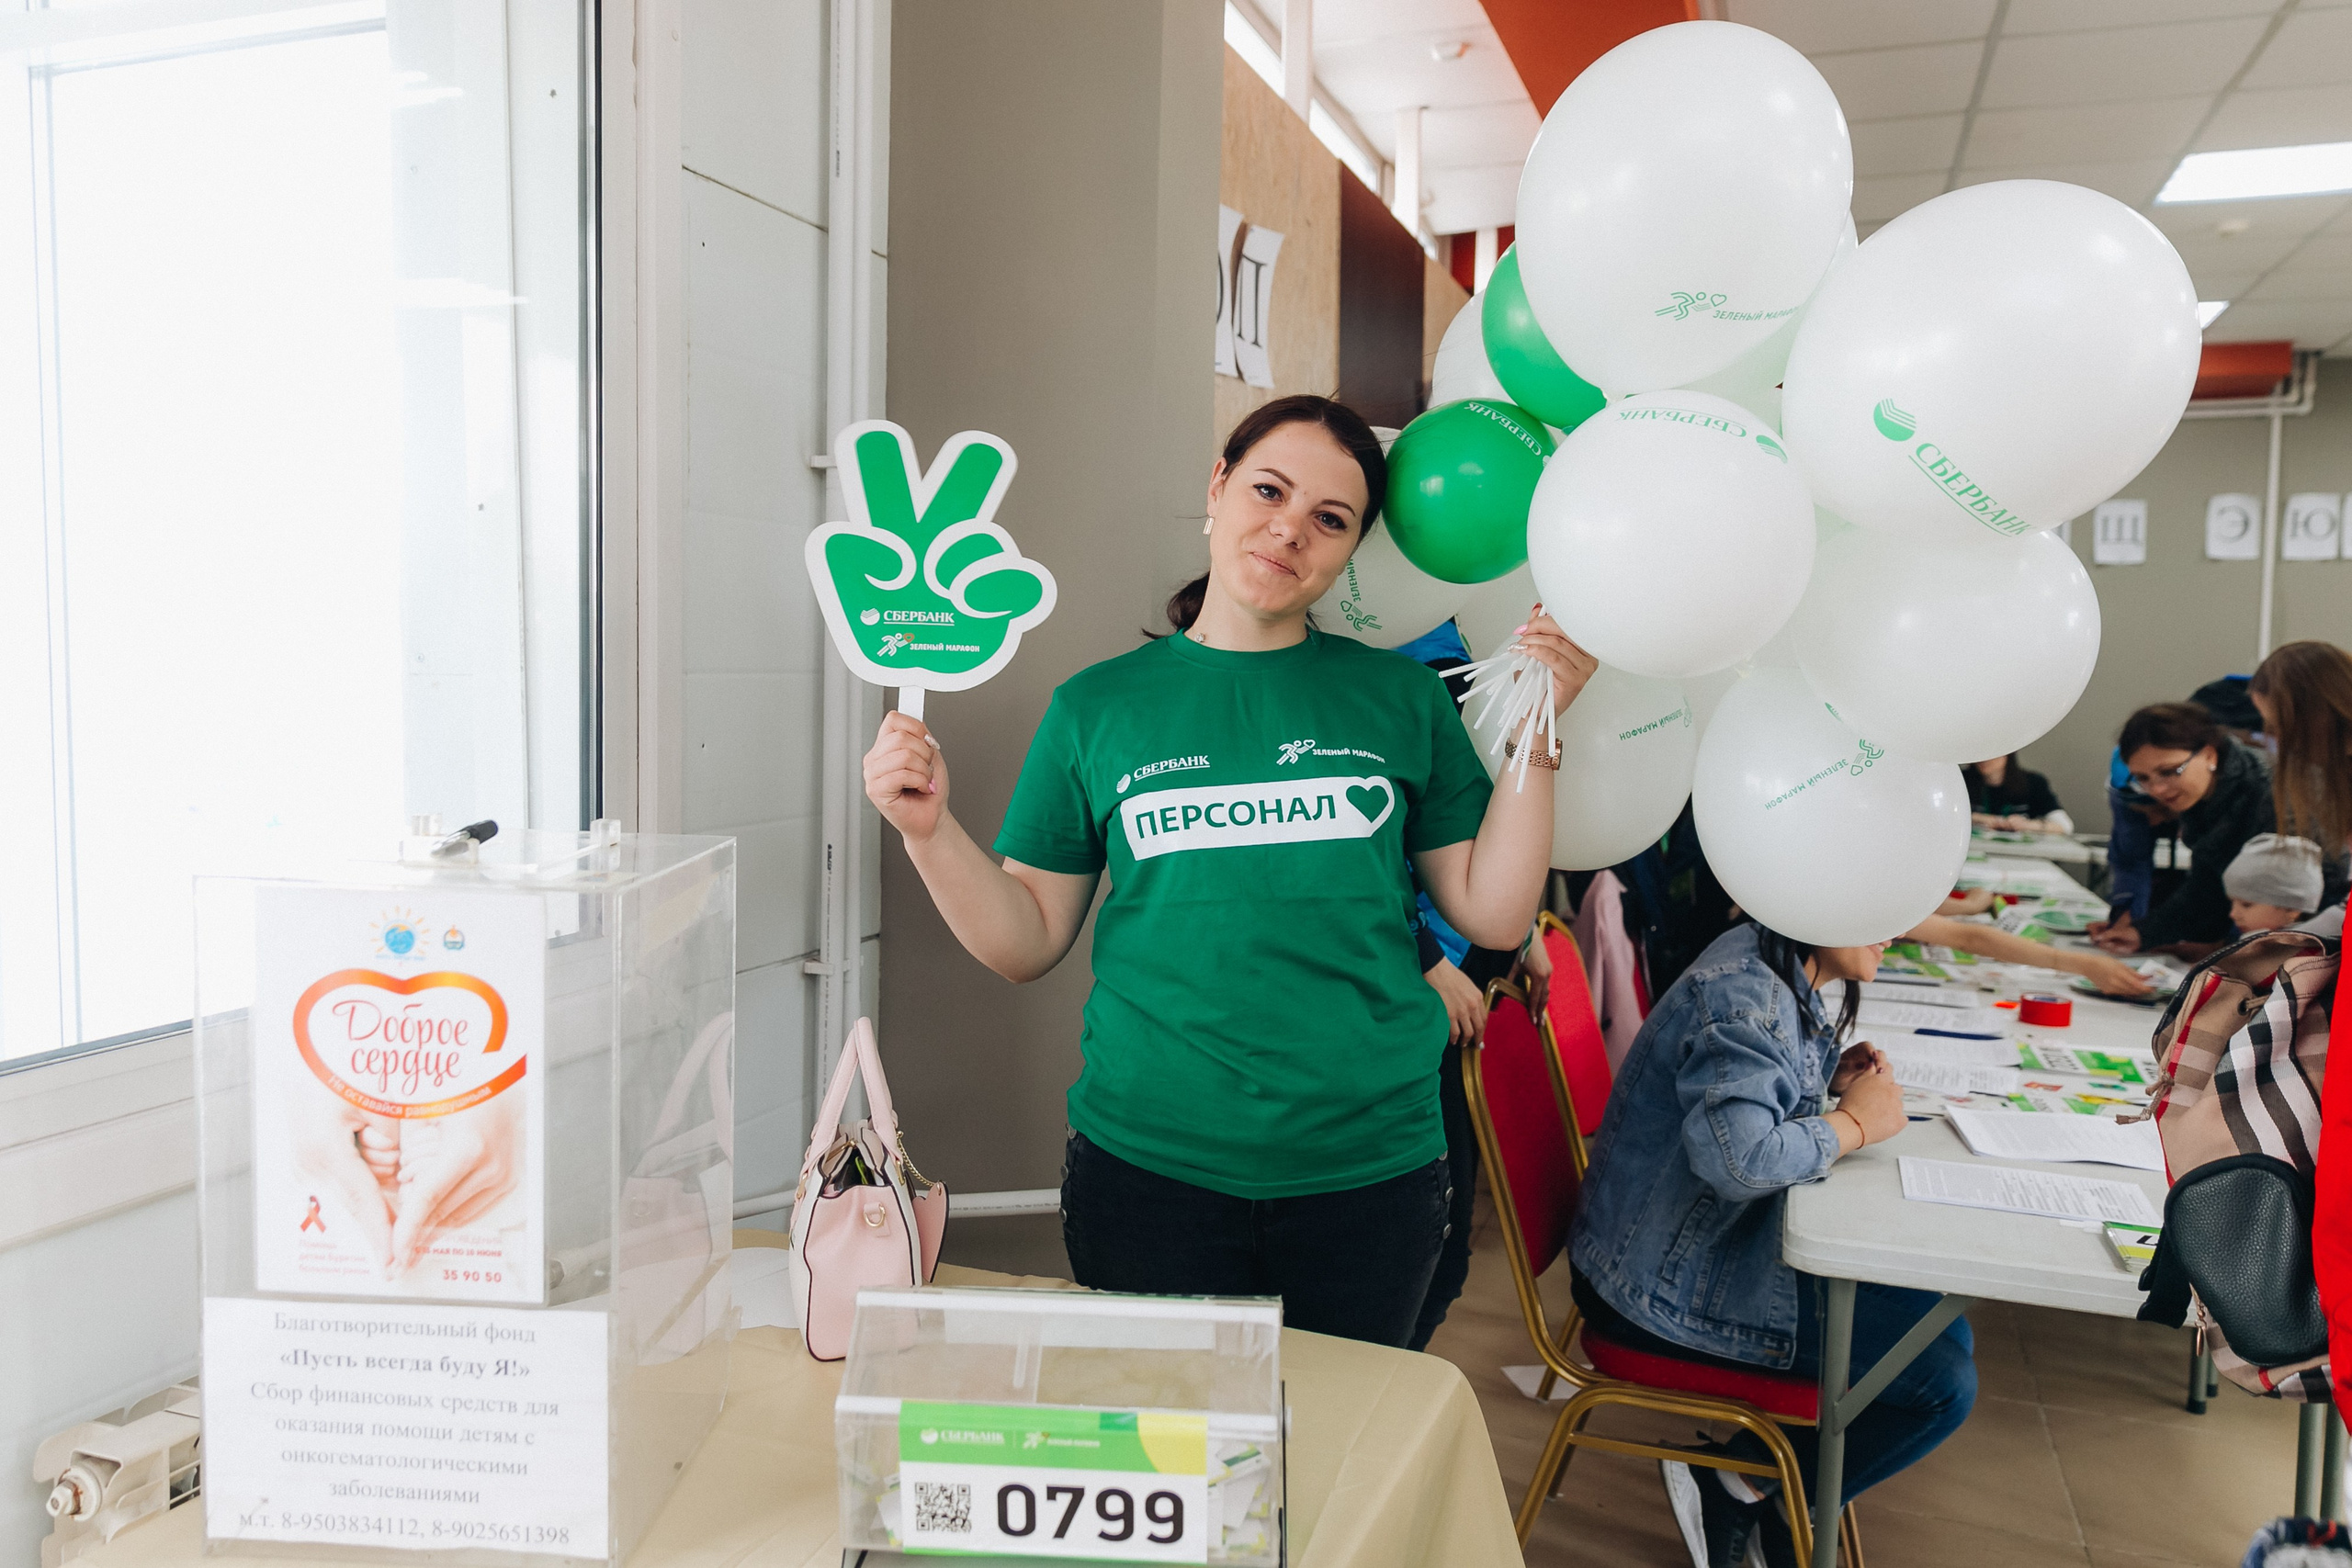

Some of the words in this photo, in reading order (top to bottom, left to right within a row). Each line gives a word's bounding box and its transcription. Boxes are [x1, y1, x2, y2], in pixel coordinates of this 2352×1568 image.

[1713, 310, 1763, 321] ЗЕЛЕНЫЙ
[1464, 402, 1542, 456] СБЕРБАНК
[1615, 410, 1747, 438] СБЕРБАНК
[1914, 442, 2036, 536] СБЕРБАНК
[2216, 505, 2249, 543] Э
[2290, 508, 2337, 541] Ю
[883, 610, 955, 625] СБЕРБАНК
[910, 643, 944, 652] ЗЕЛЕНЫЙ
[945, 644, 980, 653] МАРАФОН
[1619, 720, 1658, 741] МАРАФОН
[1312, 748, 1351, 756] ЗЕЛЕНЫЙ
[1133, 755, 1210, 781] СБЕРБАНК
[1806, 759, 1849, 787] ЗЕЛЕНЫЙ
[1764, 783, 1806, 810] МАРАФОН
[1135, 795, 1337, 840] ПЕРСОНАЛ
[332, 999, 469, 1049] Доброе
[351, 1045, 462, 1096] сердце
[443, 1269, 458, 1281] 35
[462, 1270, 481, 1282] 90
[485, 1271, 503, 1284] 50
[274, 1312, 478, 1340] Благотворительный
[484, 1322, 536, 1345] фонд
[280, 1348, 357, 1371] «Пусть
[365, 1354, 433, 1373] всегда
[439, 1354, 487, 1378] буду
[493, 1359, 530, 1378] Я!»
[250, 1382, 303, 1405] Сбор
[309, 1385, 434, 1409] финансовых
[440, 1393, 518, 1416] средств
[523, 1400, 560, 1416] для
[275, 1417, 365, 1436] оказания
[370, 1423, 454, 1442] помощи
[458, 1428, 517, 1446] детям
[524, 1431, 536, 1446] с
[281, 1447, 529, 1476] онкогематологическими
[328, 1478, 481, 1504] заболеваниями
[997, 1483, 1185, 1545] 0799
[432, 1518, 571, 1545] 8-9025651398
